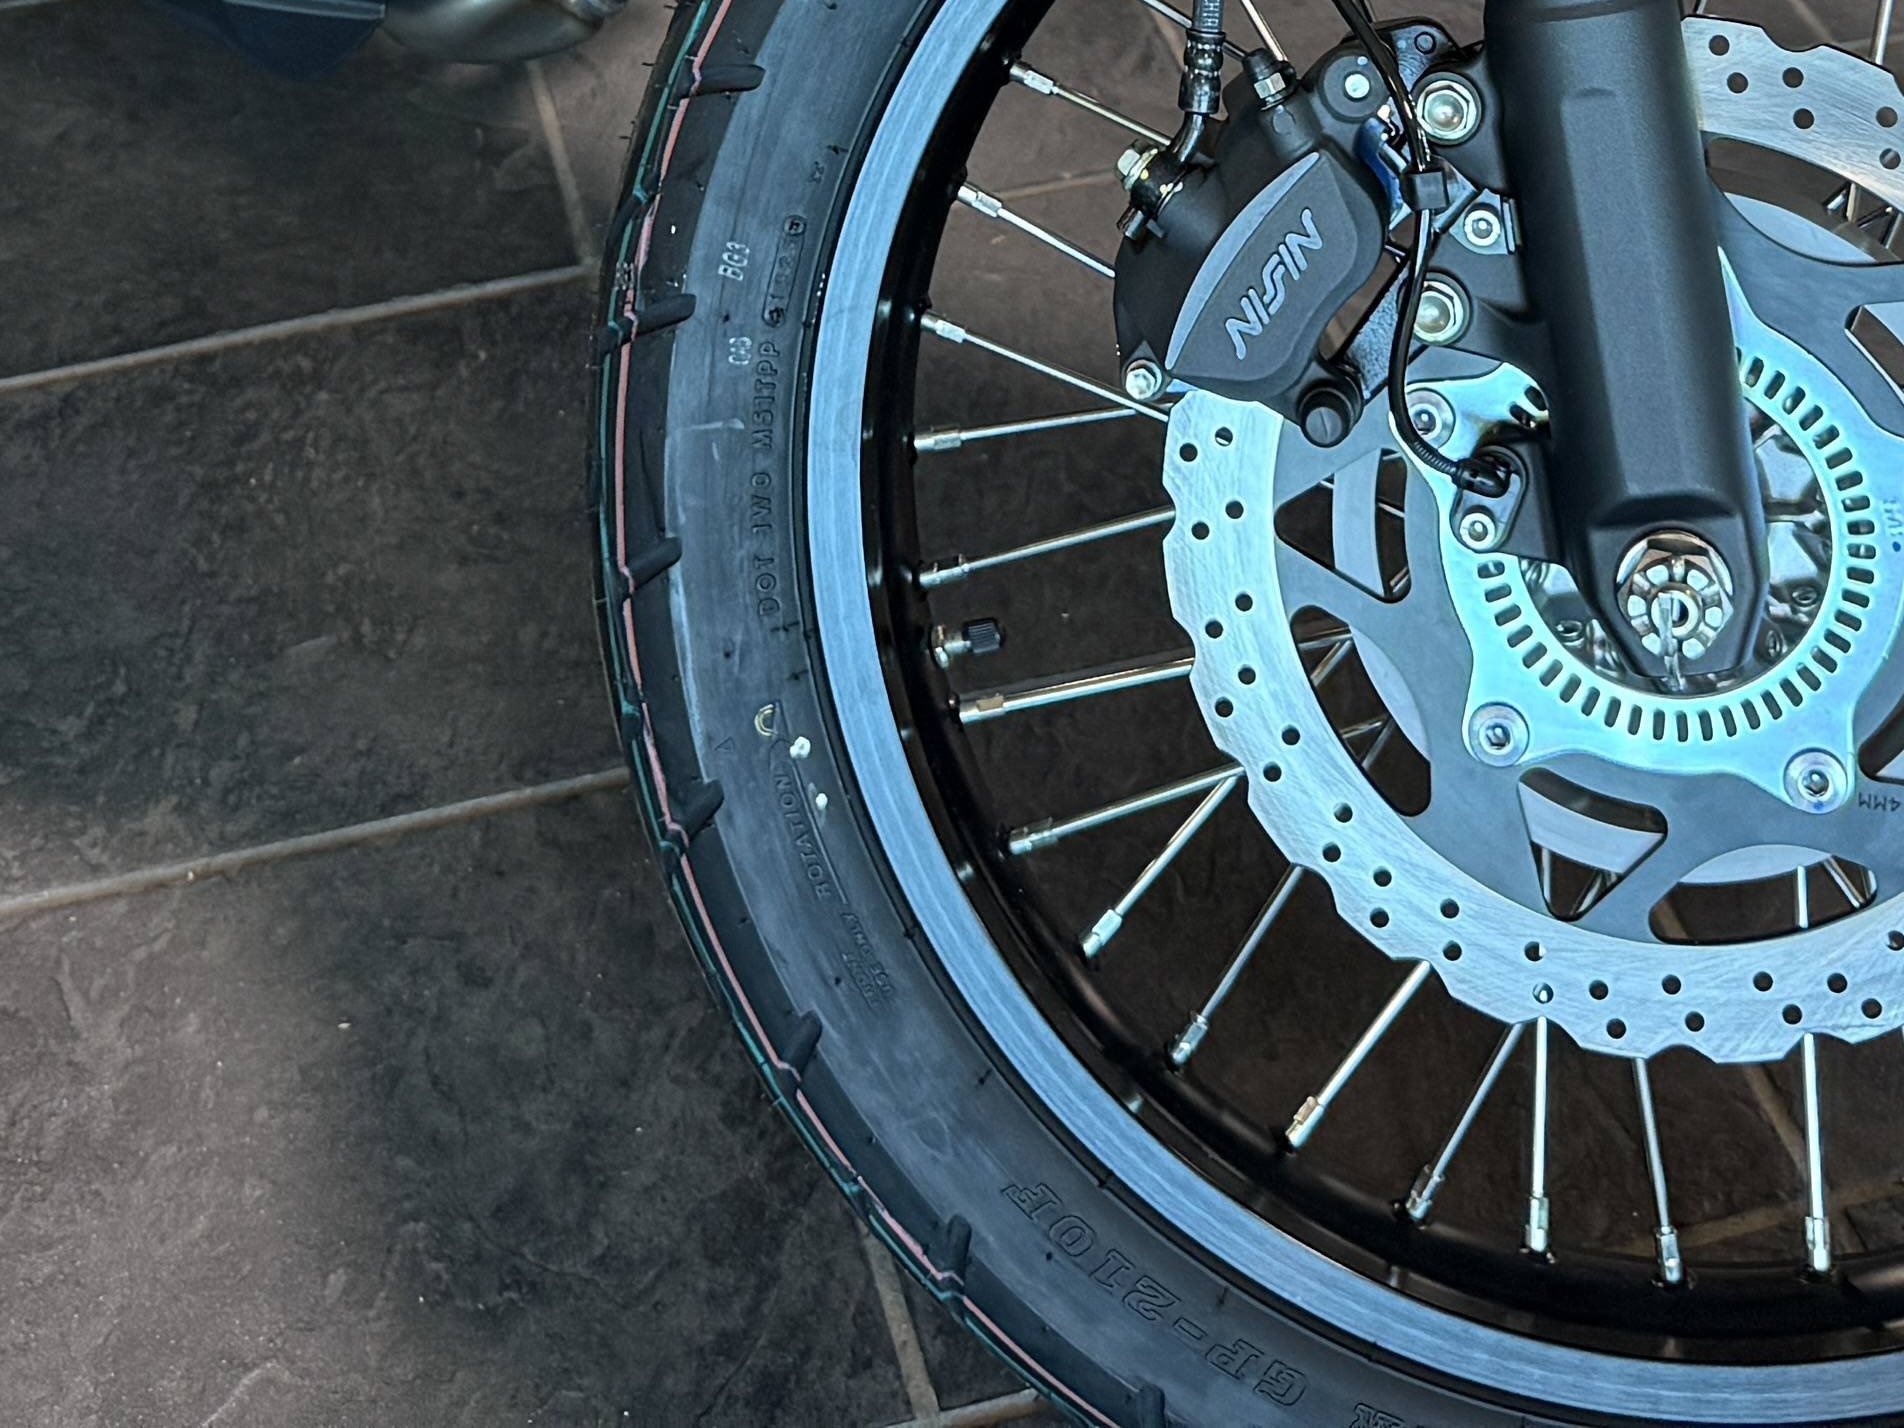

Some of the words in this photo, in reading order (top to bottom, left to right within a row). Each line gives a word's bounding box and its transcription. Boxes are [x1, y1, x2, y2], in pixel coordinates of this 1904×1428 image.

[718, 240, 752, 282] BG3
[754, 554, 783, 618] DOT
[773, 772, 833, 900] ROTATION
